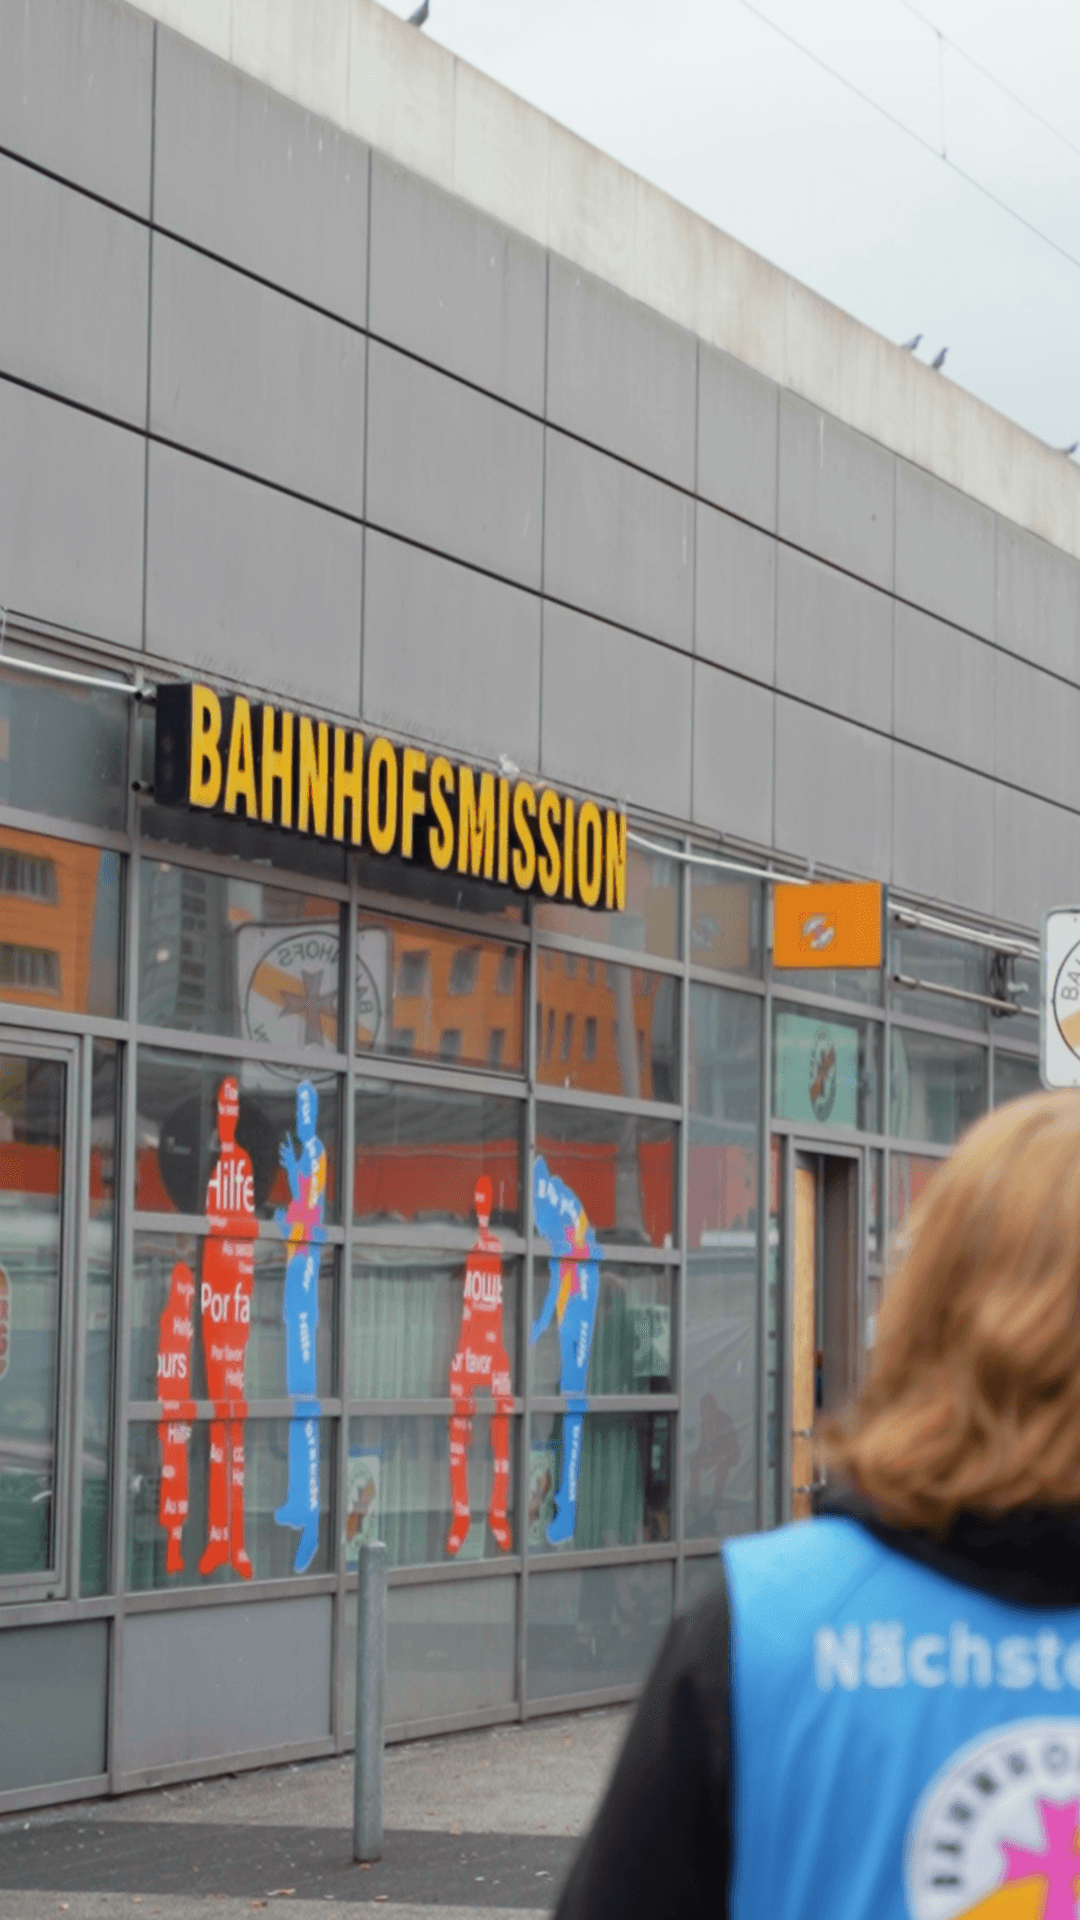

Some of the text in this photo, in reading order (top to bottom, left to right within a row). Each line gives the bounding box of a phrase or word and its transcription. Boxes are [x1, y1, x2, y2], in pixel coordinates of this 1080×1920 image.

[190, 683, 627, 912] BAHNHOFSMISSION
[1061, 955, 1080, 1001] BA
[206, 1160, 255, 1212] Hilfe
[202, 1282, 231, 1323] Por
[234, 1282, 250, 1323] fa
